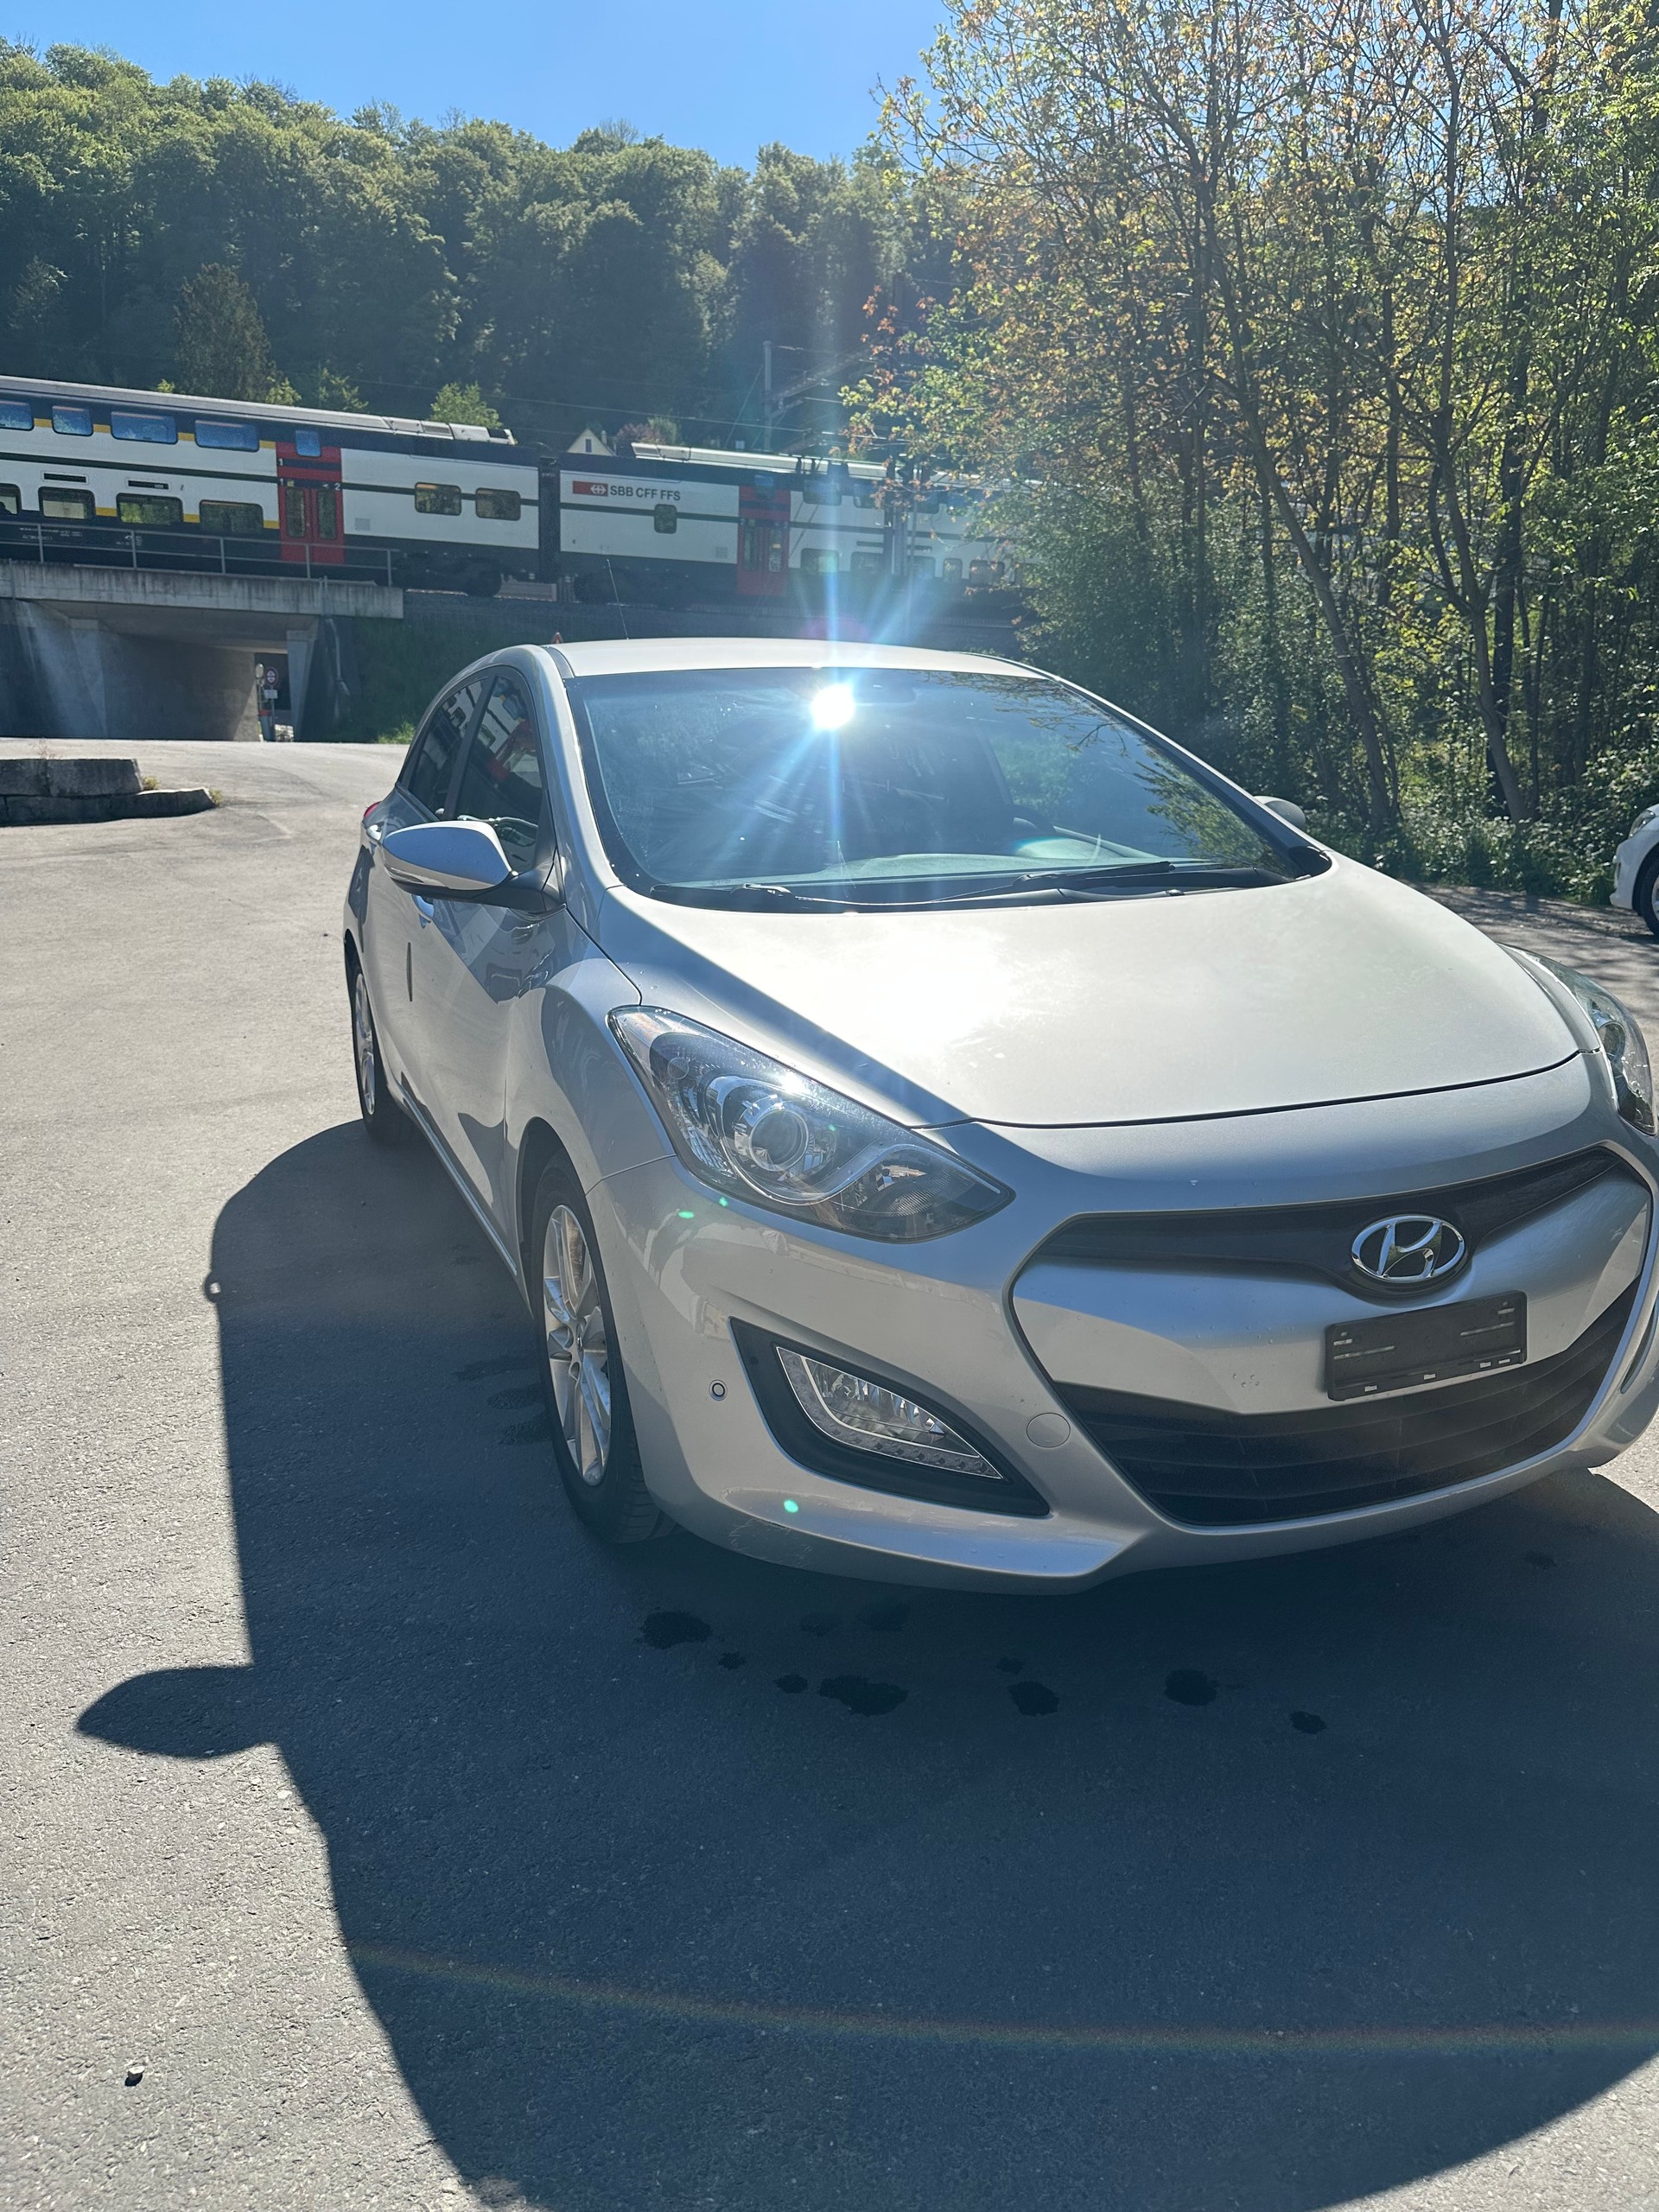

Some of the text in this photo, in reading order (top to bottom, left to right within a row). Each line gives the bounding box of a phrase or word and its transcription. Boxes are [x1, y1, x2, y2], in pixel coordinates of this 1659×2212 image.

[334, 482, 341, 491] 2
[610, 485, 681, 501] SBB CFF FFS
